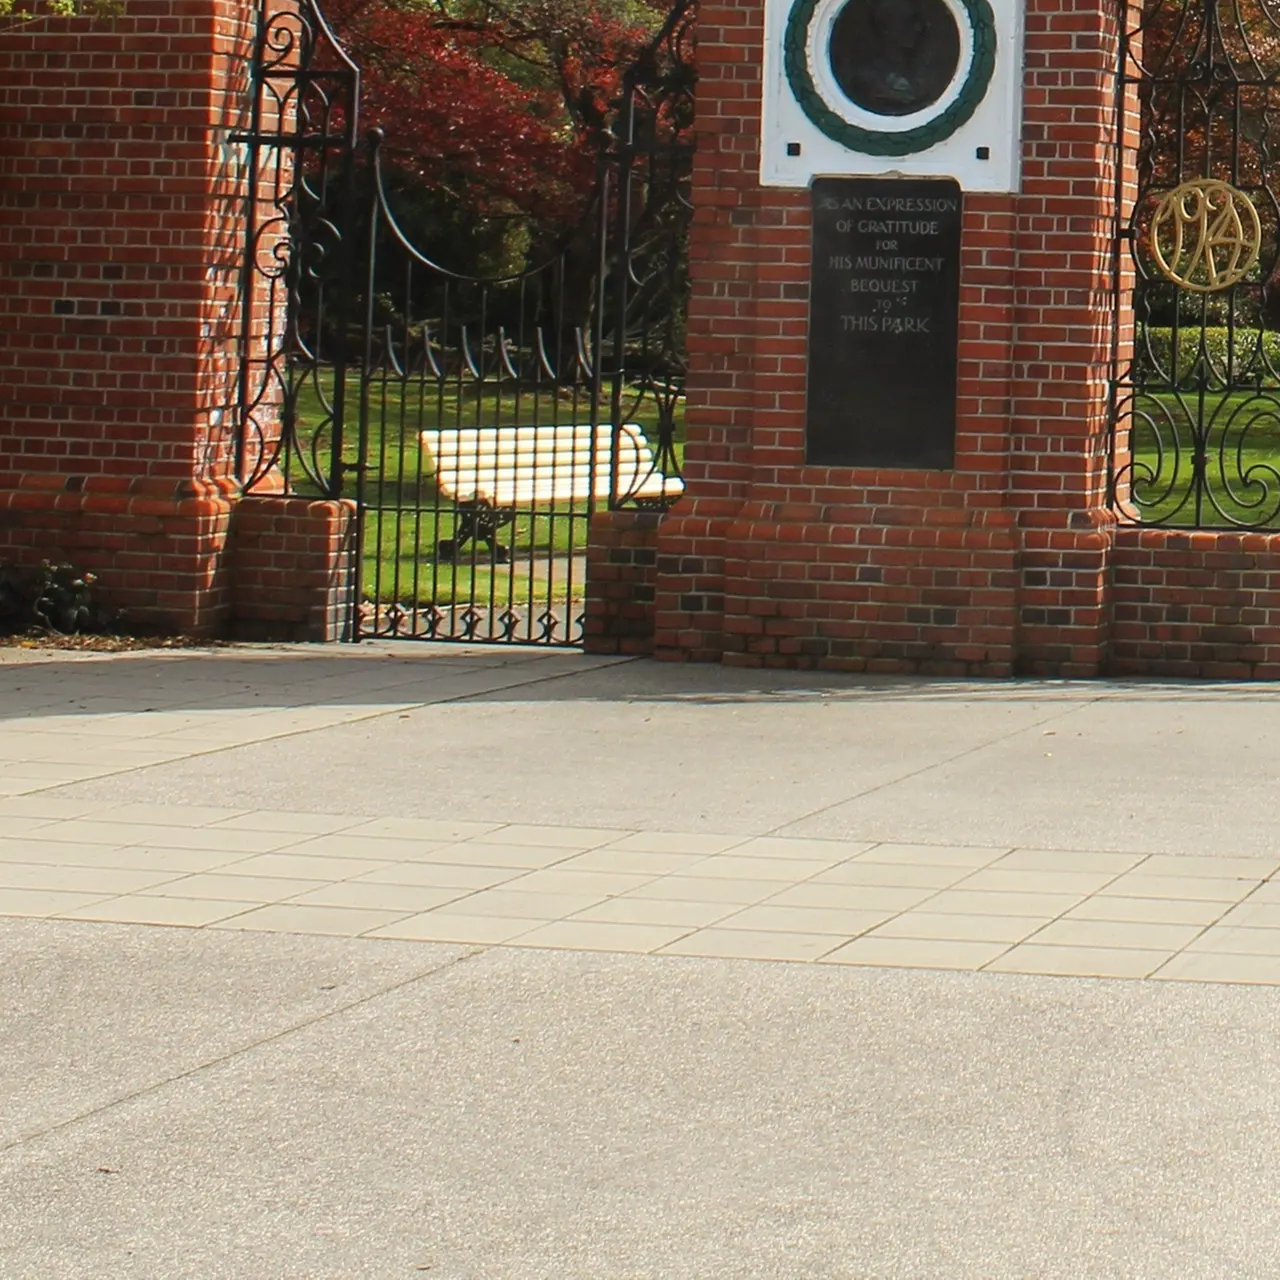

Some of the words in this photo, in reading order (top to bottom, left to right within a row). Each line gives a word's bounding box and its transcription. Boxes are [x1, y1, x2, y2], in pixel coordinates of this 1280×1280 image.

[841, 197, 863, 211] AN
[867, 197, 957, 212] EXPRESSION
[836, 219, 853, 233] OF
[858, 220, 939, 234] GRATITUDE
[876, 239, 899, 251] FOR
[829, 256, 852, 270] HIS
[855, 256, 945, 271] MUNIFICENT
[851, 279, 920, 293] BEQUEST
[876, 299, 892, 309] TO
[840, 316, 878, 331] THIS
[882, 317, 930, 333] PARK
